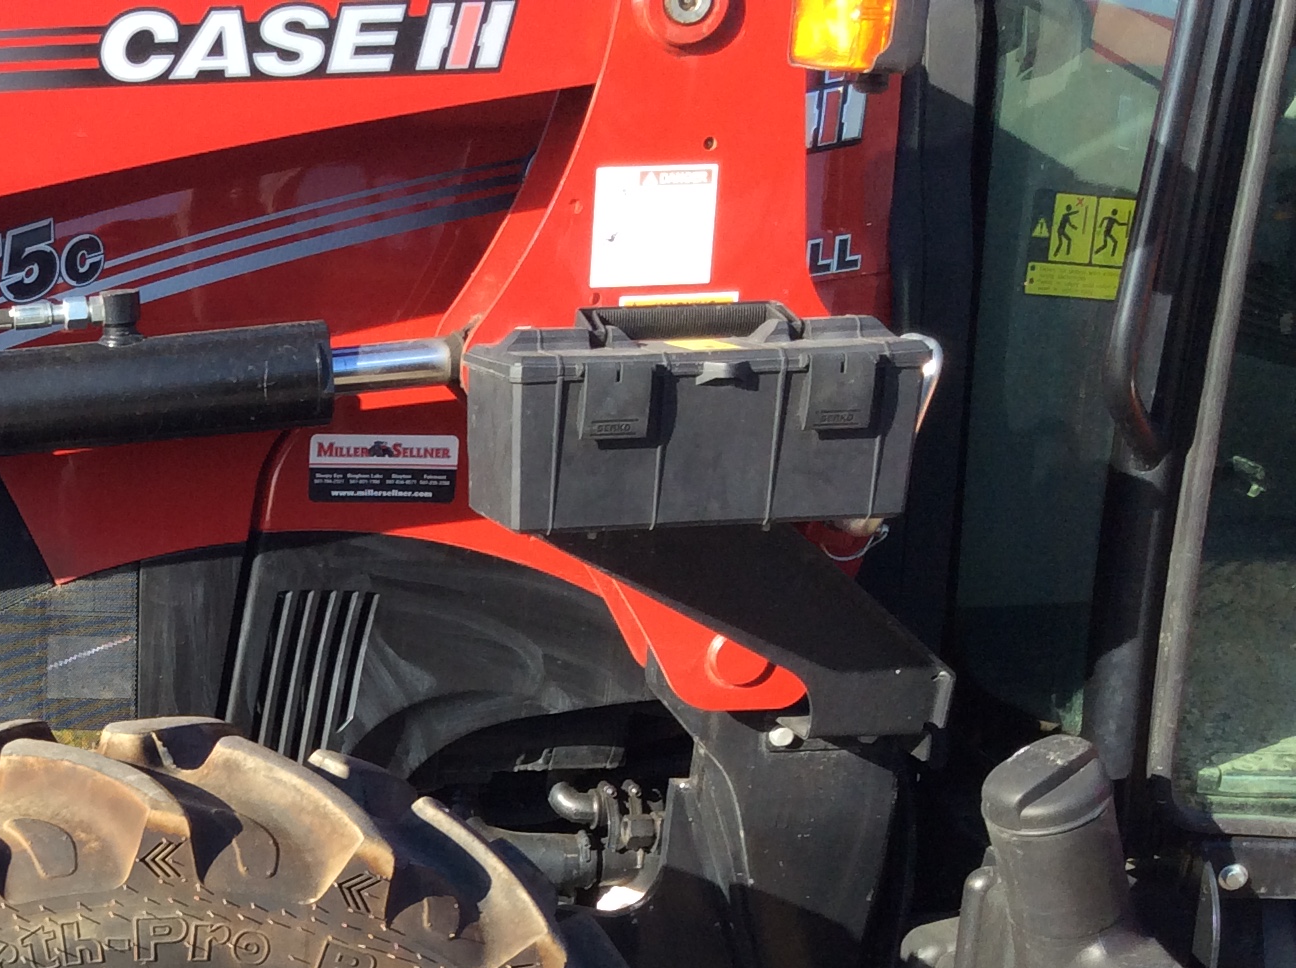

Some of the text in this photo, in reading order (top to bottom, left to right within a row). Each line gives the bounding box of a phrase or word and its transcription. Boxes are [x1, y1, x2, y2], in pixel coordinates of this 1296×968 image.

[100, 4, 406, 84] CASE
[316, 441, 451, 459] MILLER SELLNER
